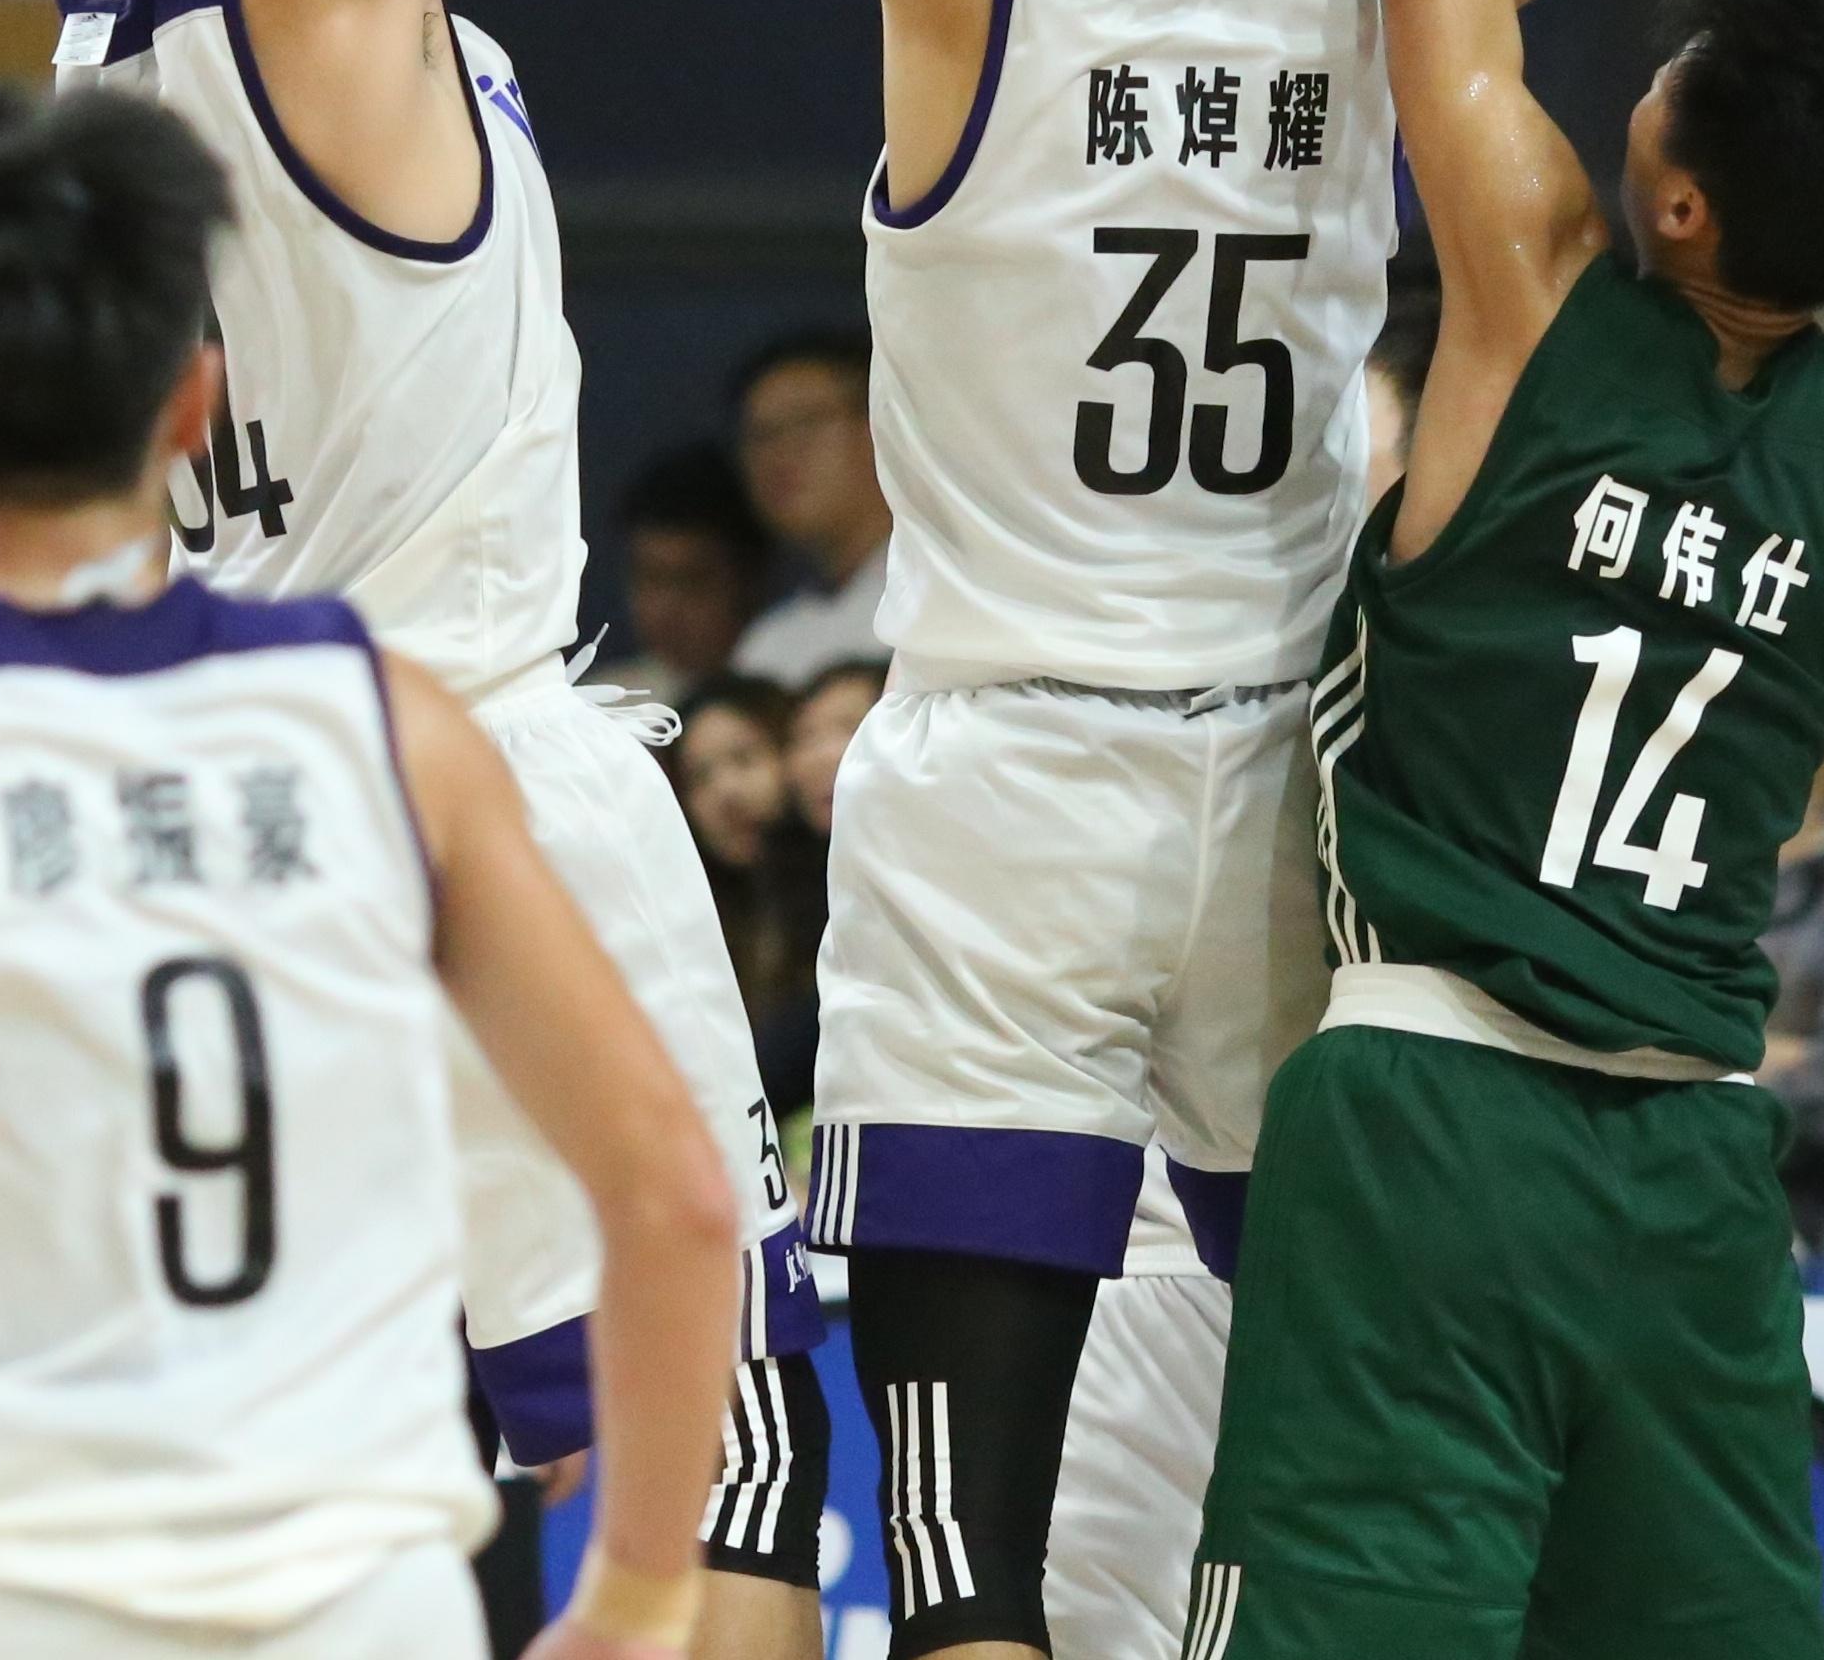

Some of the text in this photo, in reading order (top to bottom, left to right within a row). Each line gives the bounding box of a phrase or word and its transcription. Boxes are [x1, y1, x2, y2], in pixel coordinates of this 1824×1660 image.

[1085, 64, 1330, 170] 陈焯耀
[1073, 227, 1310, 495] 35
[1567, 473, 1810, 635] 何伟仕
[1538, 625, 1744, 911] 14
[138, 952, 277, 1312] 9
